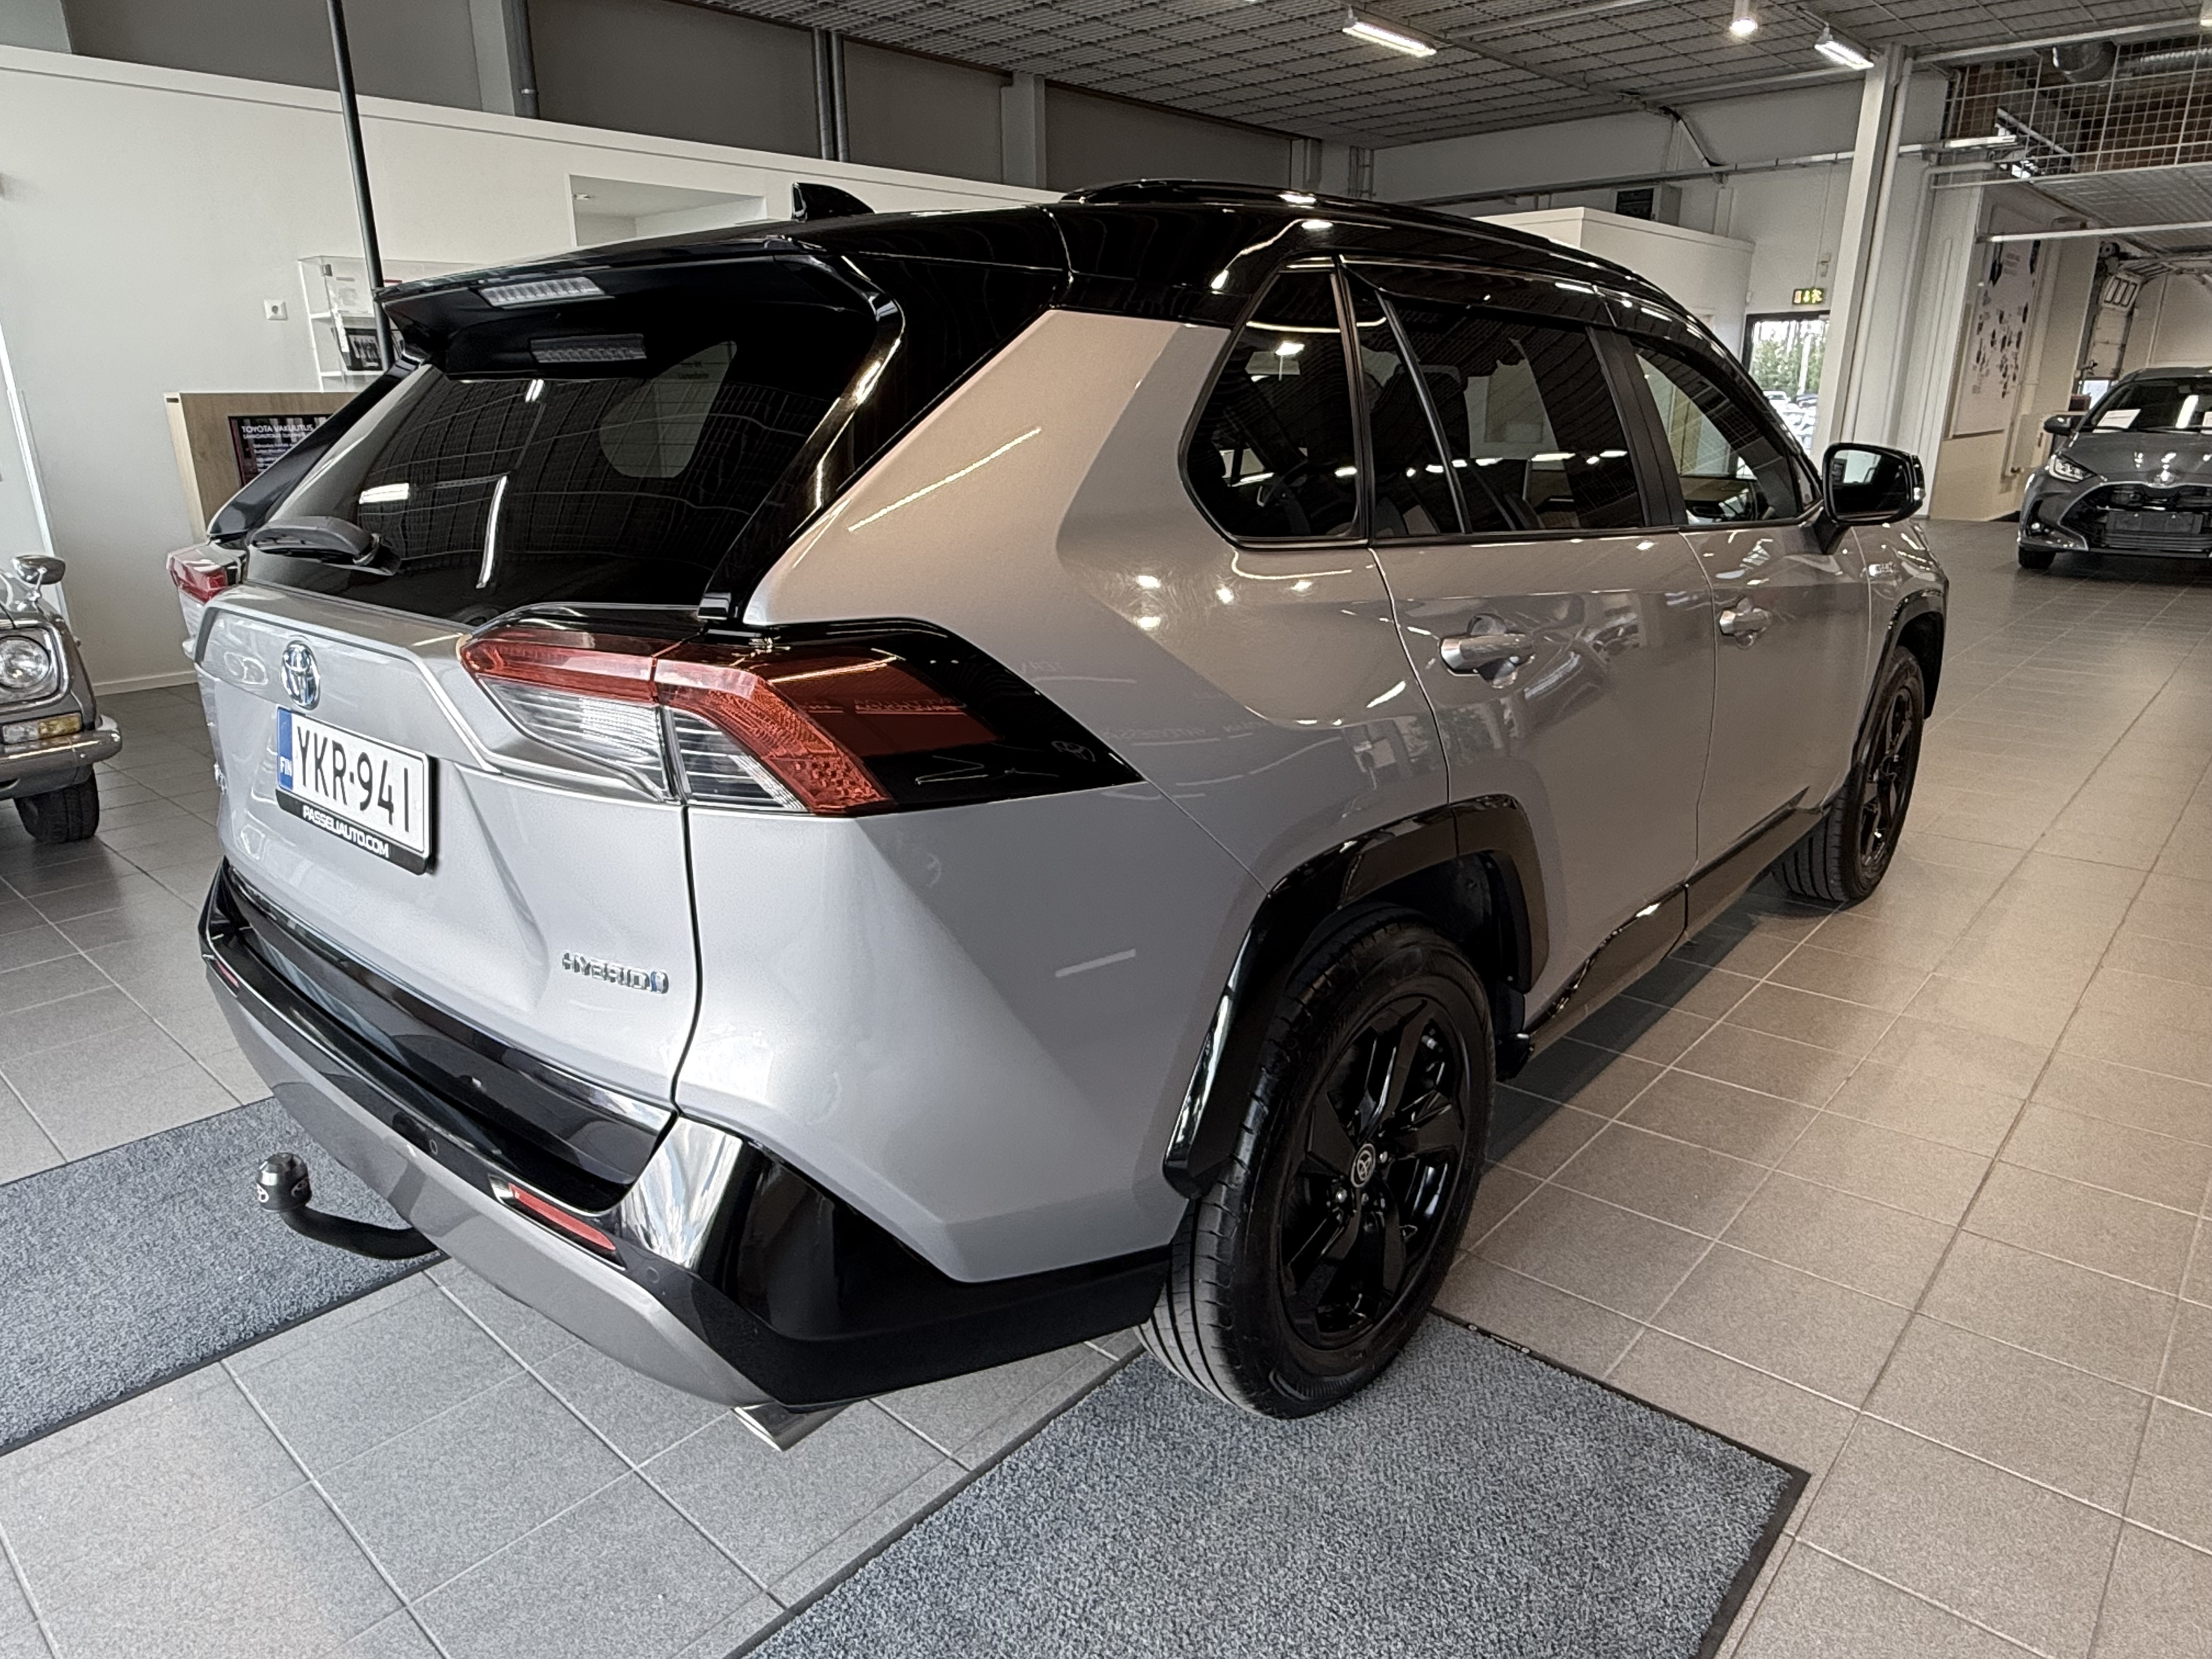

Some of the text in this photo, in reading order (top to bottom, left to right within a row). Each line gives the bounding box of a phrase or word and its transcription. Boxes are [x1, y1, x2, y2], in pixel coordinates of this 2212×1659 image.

[280, 757, 292, 777] FIN
[297, 725, 409, 833] YKR-941
[562, 950, 650, 991] HYBRID
